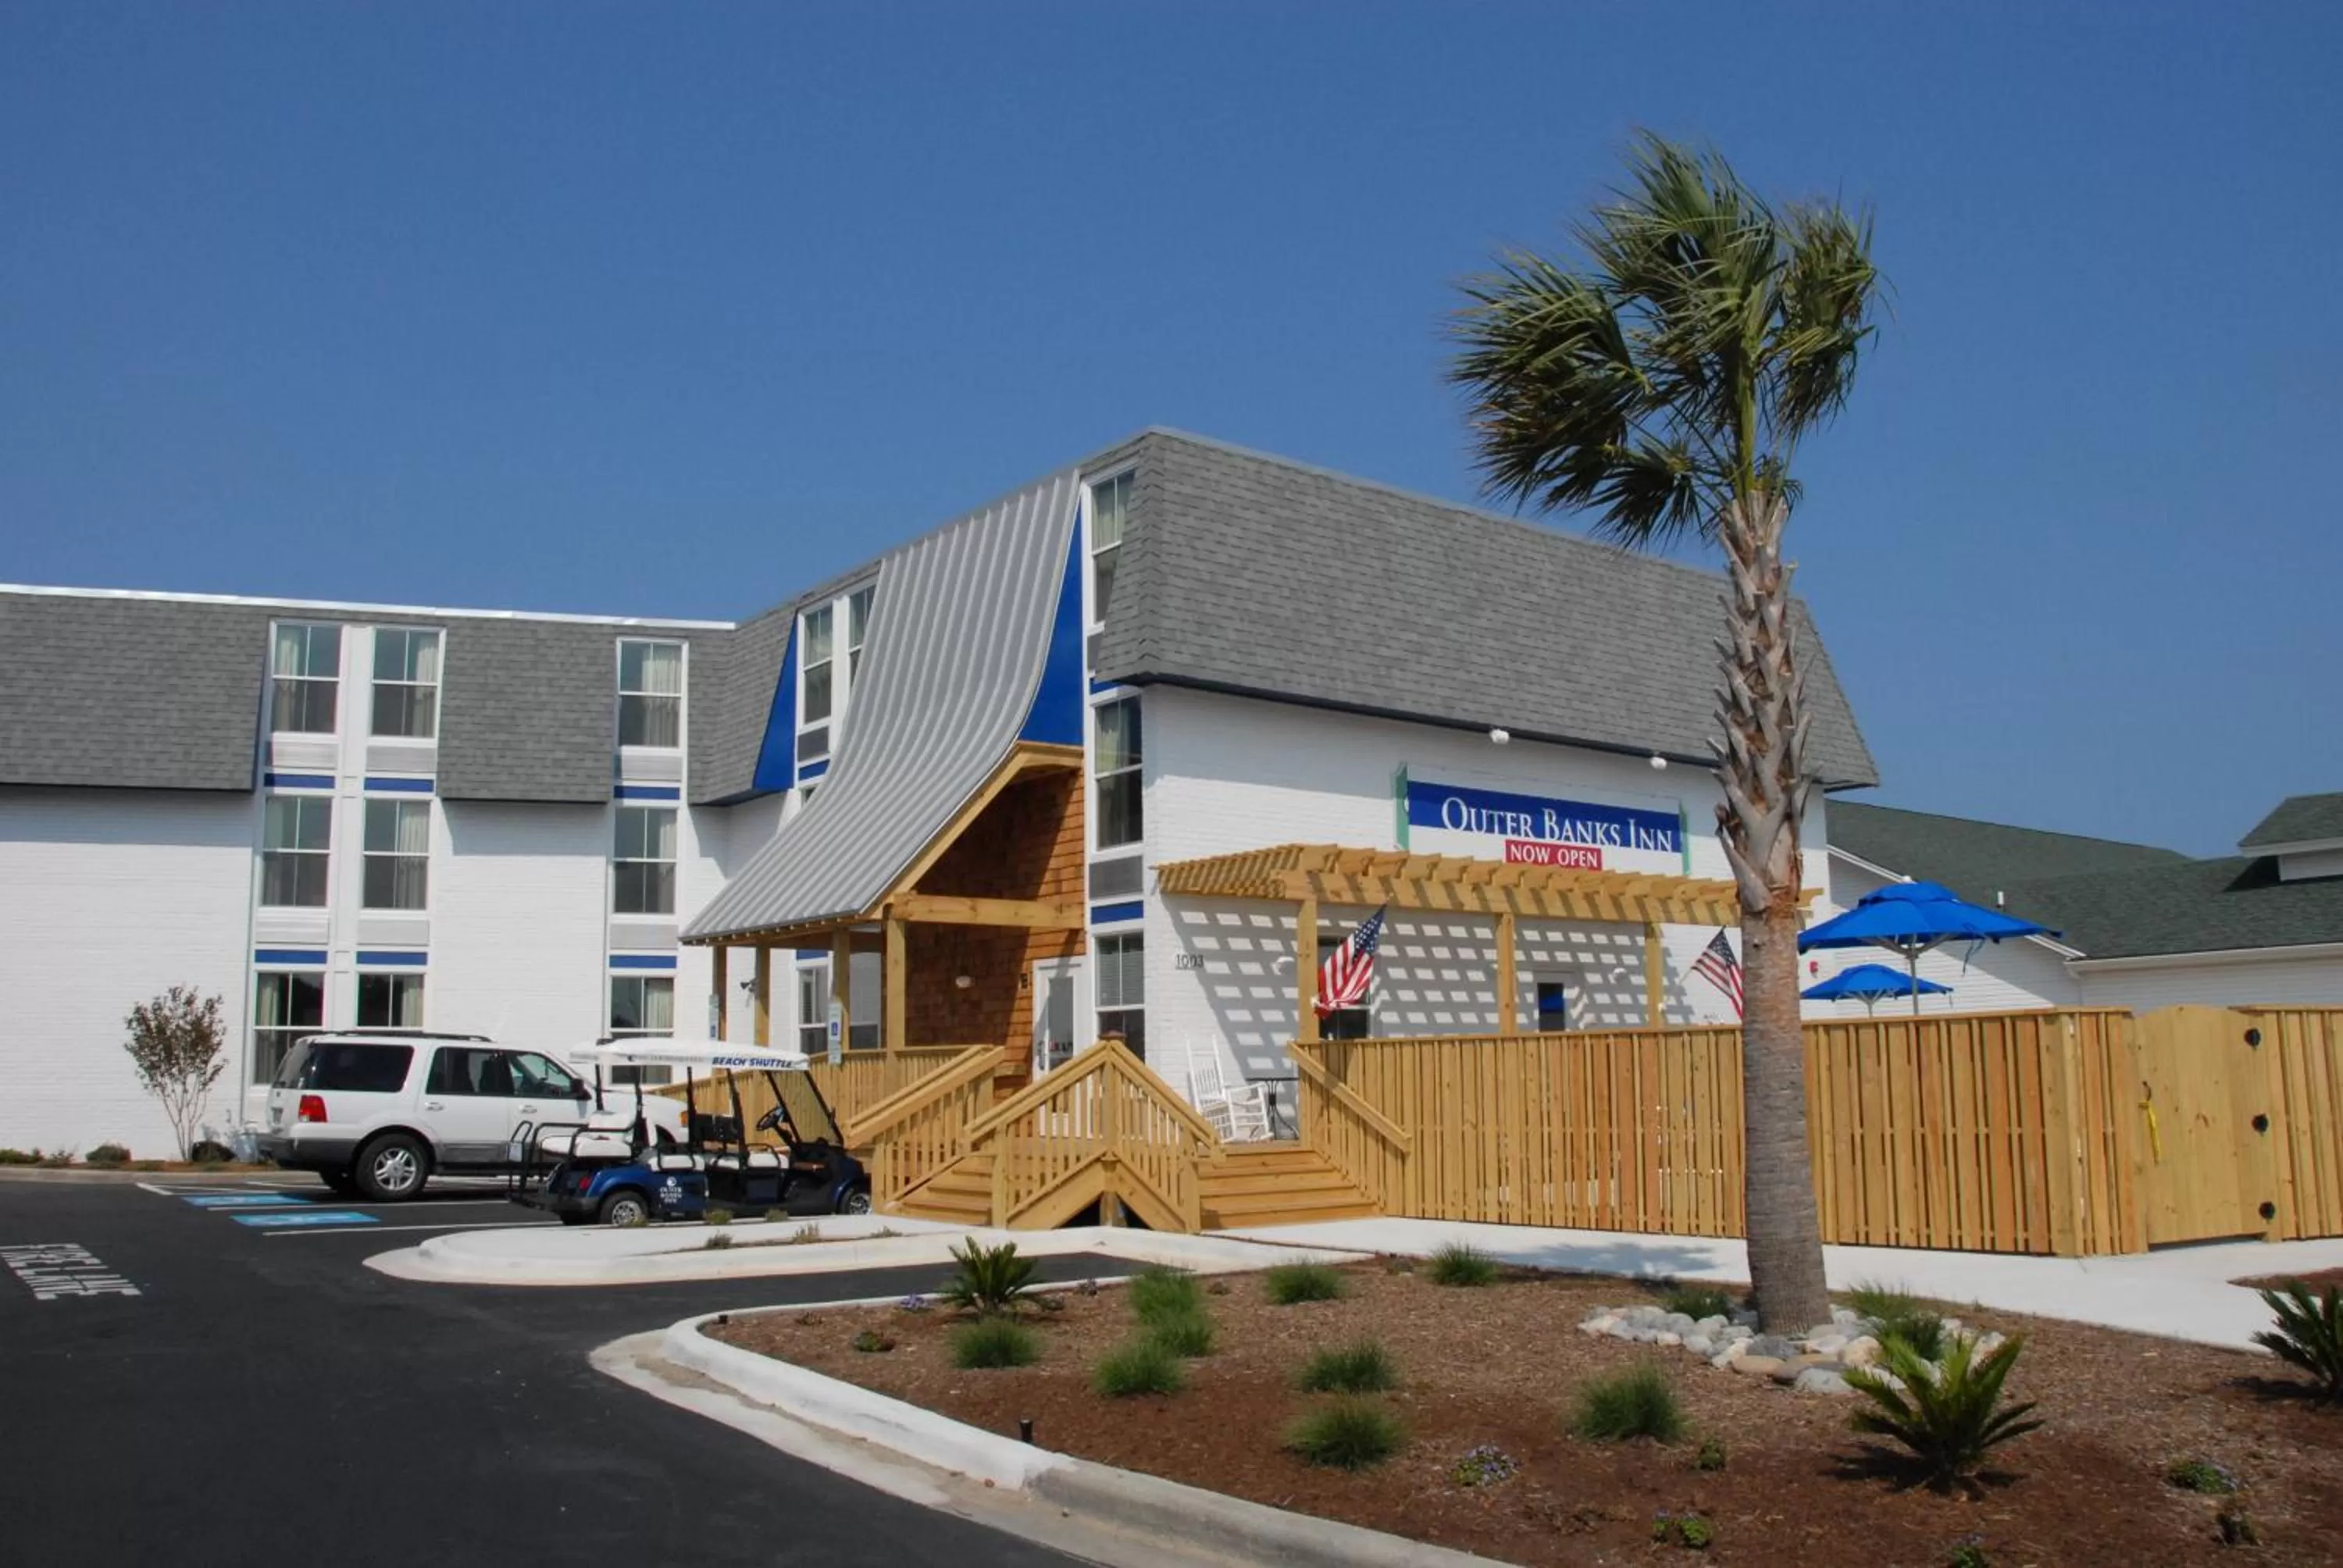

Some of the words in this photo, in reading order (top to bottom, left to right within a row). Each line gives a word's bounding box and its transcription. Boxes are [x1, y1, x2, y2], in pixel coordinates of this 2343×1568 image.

[1441, 796, 1535, 839] OUTER
[1542, 807, 1621, 848] BANKS
[1628, 819, 1672, 853] INN
[1509, 844, 1550, 864] NOW
[1557, 849, 1599, 868] OPEN
[711, 1057, 747, 1066] BEACH
[748, 1058, 793, 1068] SHUTTLE
